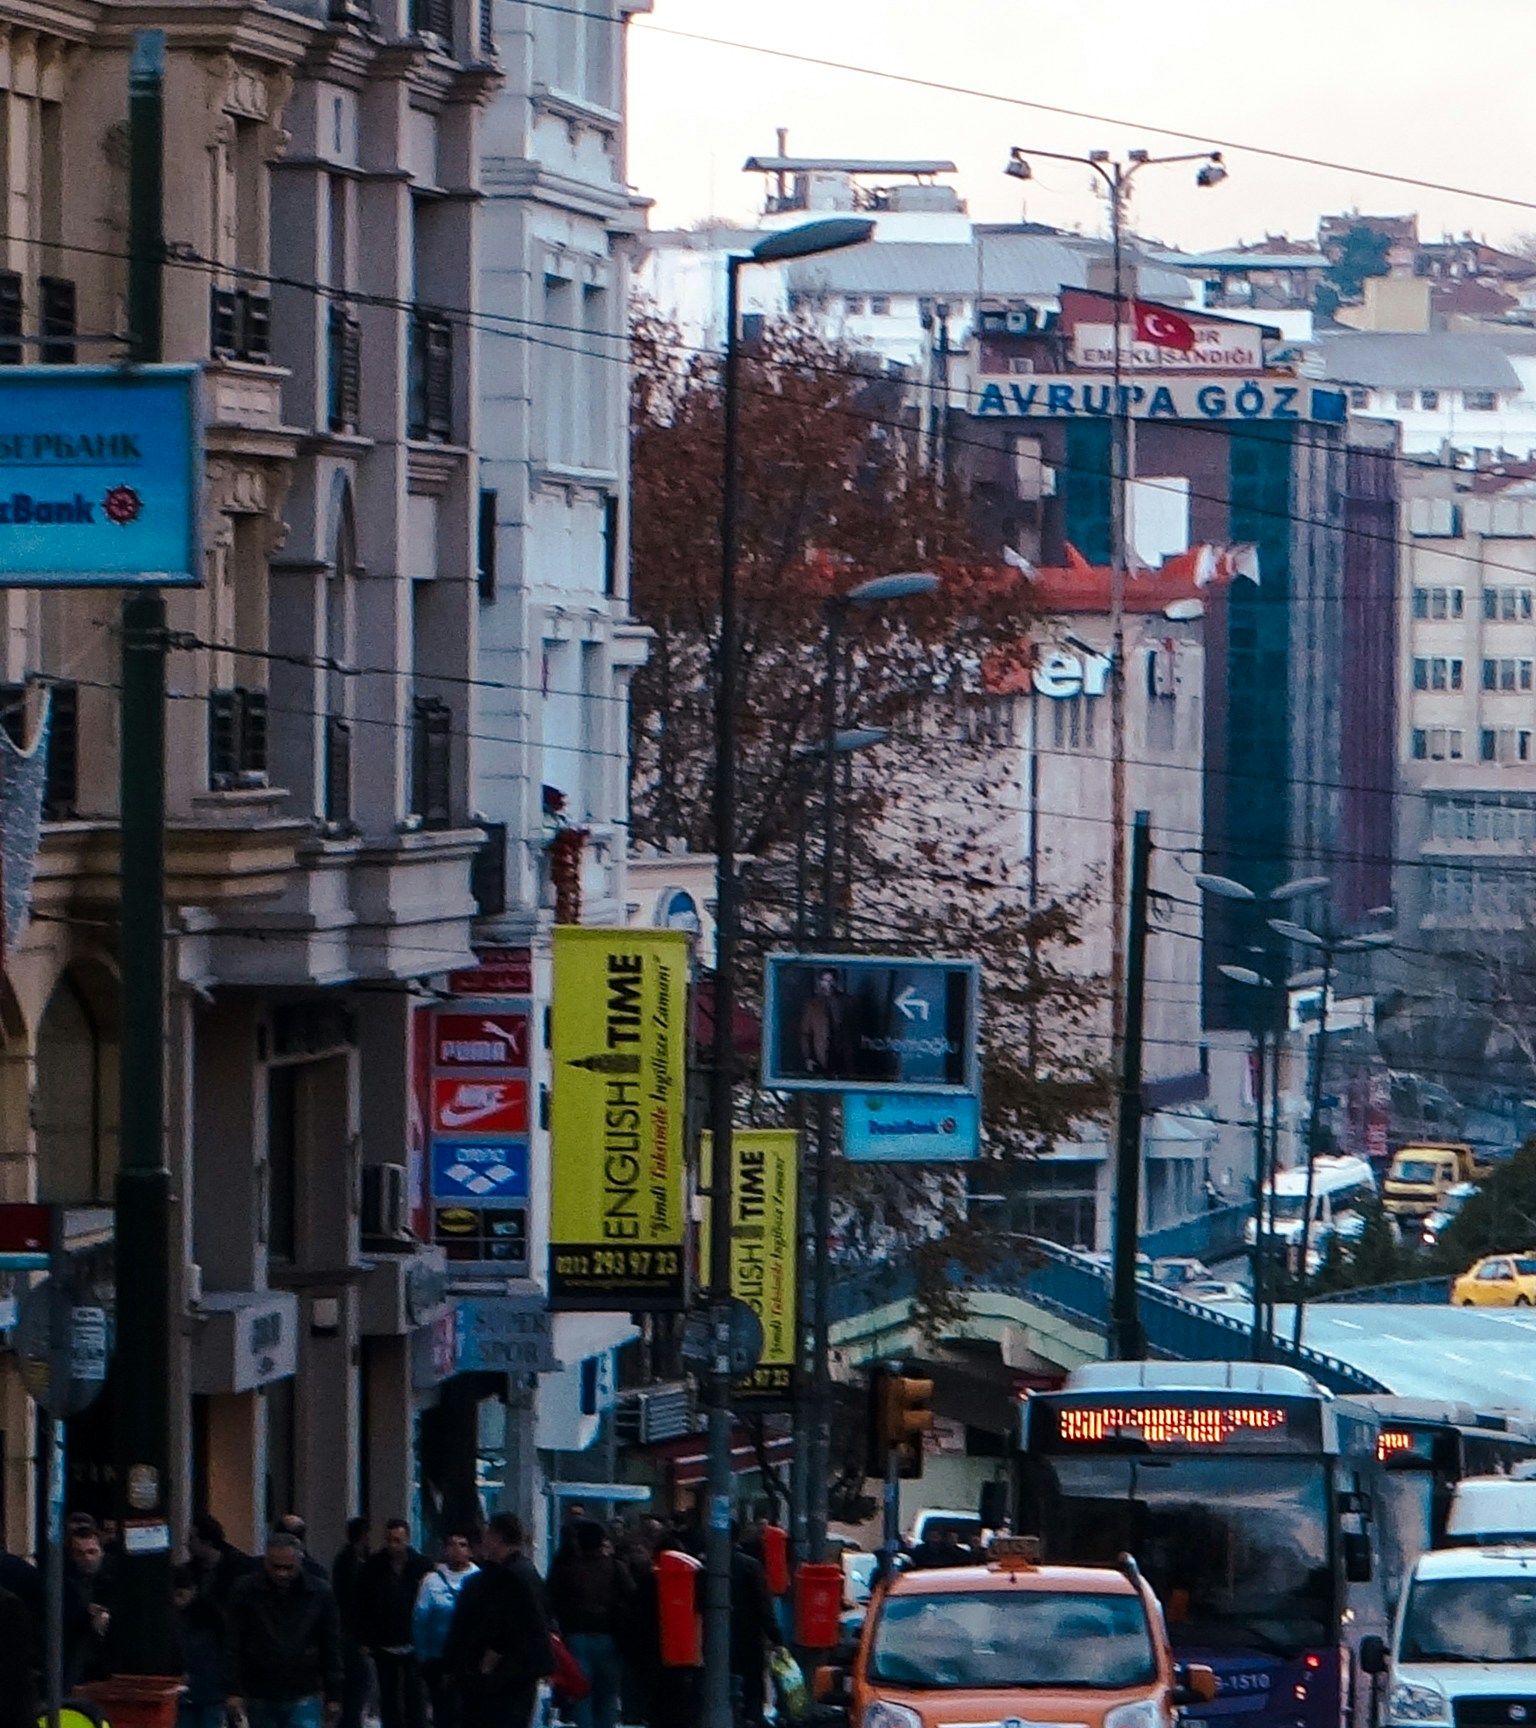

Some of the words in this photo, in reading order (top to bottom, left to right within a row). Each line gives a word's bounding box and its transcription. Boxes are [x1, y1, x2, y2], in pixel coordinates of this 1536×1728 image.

[977, 382, 1178, 418] AVRUPA
[1197, 379, 1300, 419] GÖZ
[606, 954, 643, 1049] TIME
[604, 1081, 641, 1240] ENGLISH
[739, 1150, 766, 1221] TIME
[593, 1251, 626, 1275] 293
[629, 1251, 651, 1275] 97
[655, 1251, 679, 1276] 23
